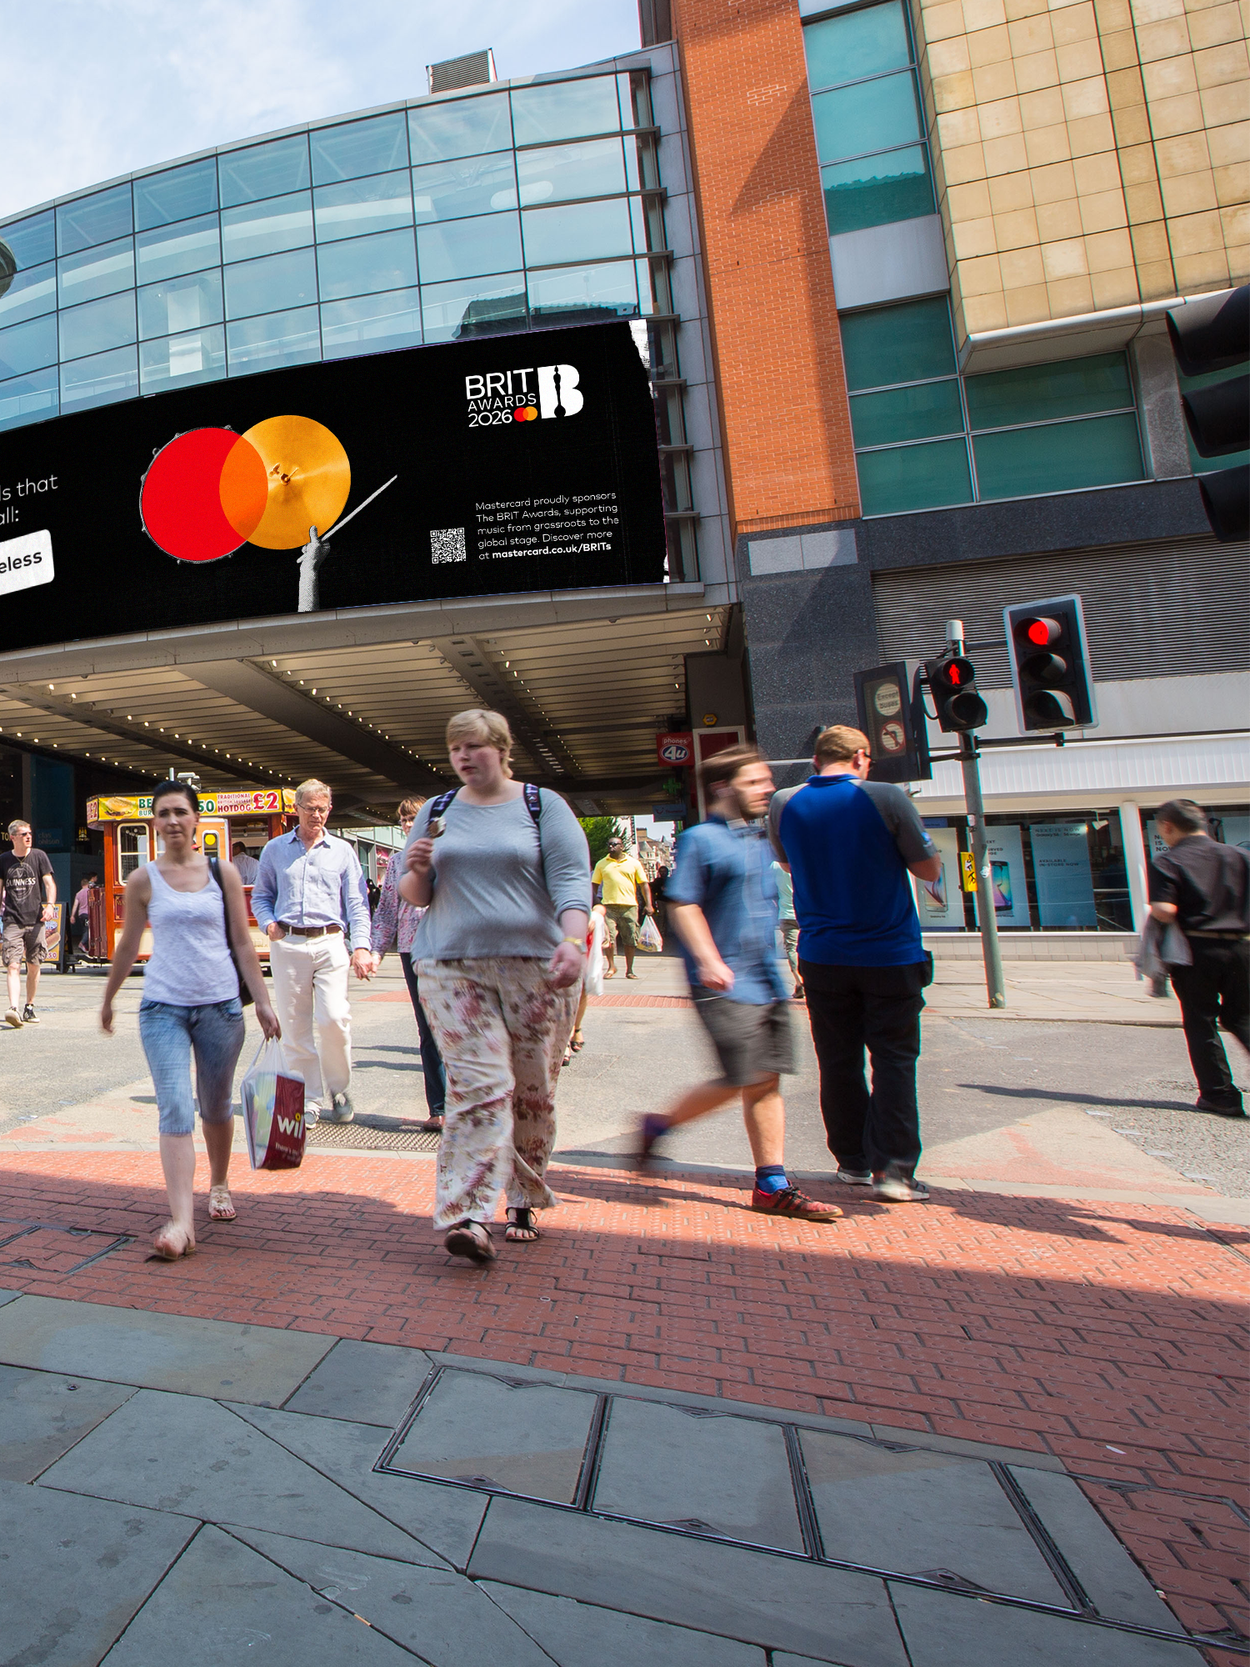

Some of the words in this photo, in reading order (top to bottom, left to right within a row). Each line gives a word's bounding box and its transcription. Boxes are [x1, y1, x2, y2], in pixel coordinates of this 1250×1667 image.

[465, 368, 534, 400] BRIT
[468, 393, 537, 412] AWARDS
[468, 409, 513, 428] 2026
[16, 474, 58, 497] that
[475, 498, 531, 511] Mastercard
[533, 494, 569, 507] proudly
[572, 492, 616, 504] sponsors
[476, 514, 494, 523] The
[496, 511, 519, 521] BRIT
[522, 508, 561, 519] Awards,
[563, 504, 618, 517] supporting
[477, 526, 505, 535] music
[507, 523, 532, 533] from
[534, 519, 586, 532] grassroots
[589, 518, 600, 526] to
[602, 516, 619, 525] the
[477, 537, 508, 550] global
[510, 536, 540, 548] stage.
[542, 532, 584, 543] Discover
[587, 530, 613, 539] more
[478, 552, 490, 560] at
[492, 542, 612, 560] mastercard.co.uk/BRITs
[664, 746, 686, 760] 4u
[217, 804, 251, 813] HOTDOG
[253, 792, 278, 810] £2
[6, 878, 36, 887] GUINNESS
